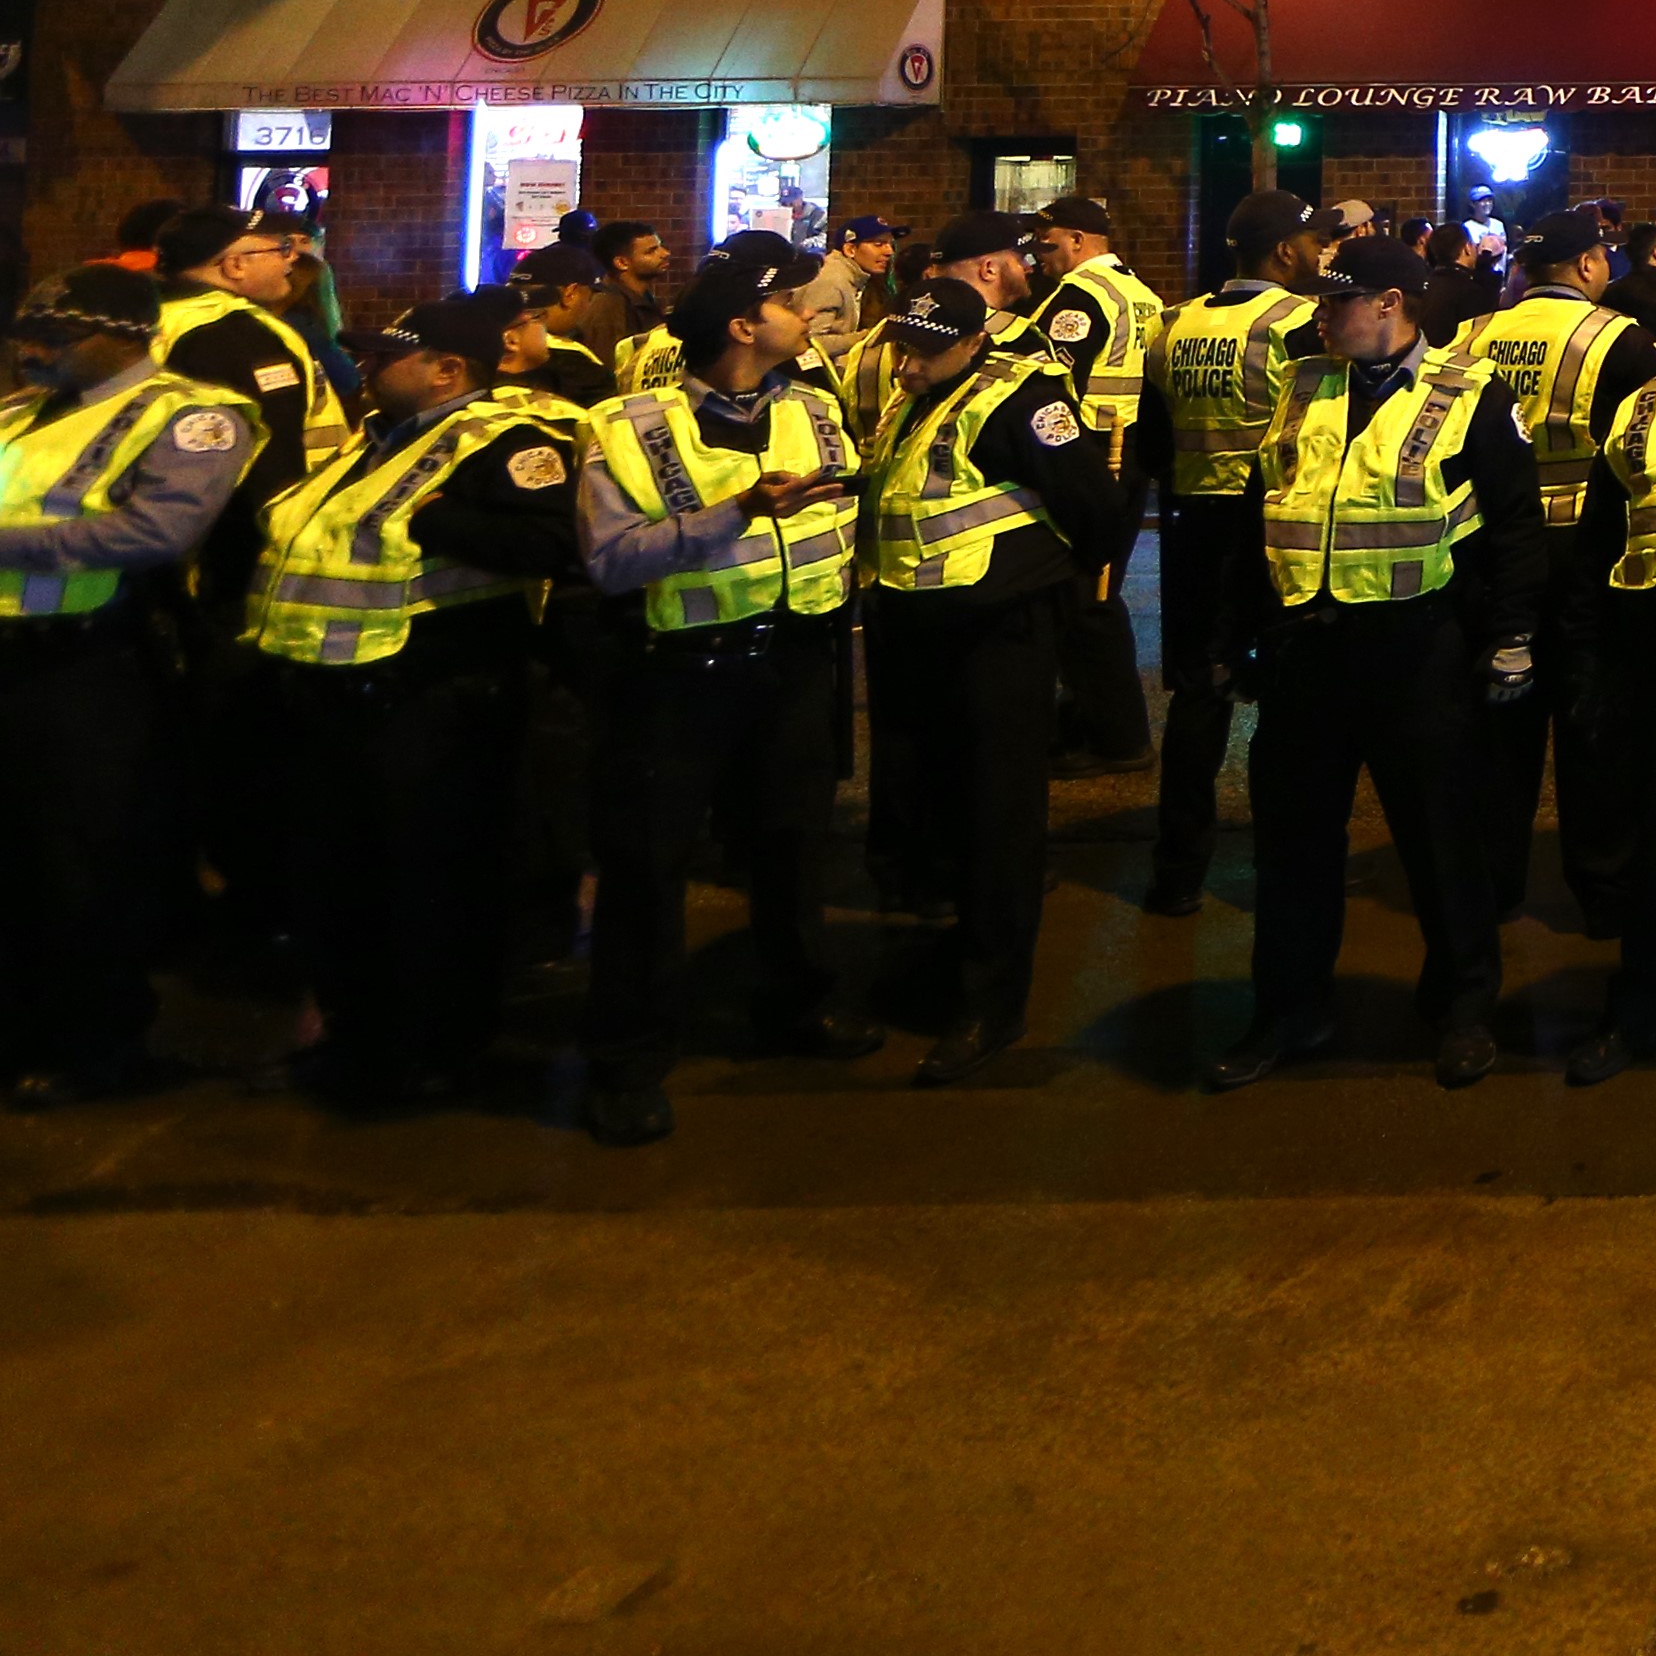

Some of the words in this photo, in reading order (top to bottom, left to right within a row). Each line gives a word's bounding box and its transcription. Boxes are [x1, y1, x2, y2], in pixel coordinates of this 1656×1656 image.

[242, 85, 285, 102] THE
[294, 85, 350, 102] BEST
[359, 84, 412, 102] MAC
[456, 84, 548, 102] CHEESE
[552, 84, 611, 101] PIZZA
[619, 83, 638, 100] IN
[644, 83, 685, 100] THE
[695, 82, 745, 100] CITY
[1292, 87, 1463, 109] LOUNGE
[1474, 85, 1577, 105] RAW
[1172, 337, 1237, 368] CHICAGO
[1488, 340, 1548, 366] CHICAGO
[1172, 368, 1234, 398] POLICE
[1502, 370, 1541, 396] LICE
[1036, 404, 1072, 430] CHICAGO
[1401, 401, 1449, 477] POLICE
[644, 425, 702, 513] CHICAG
